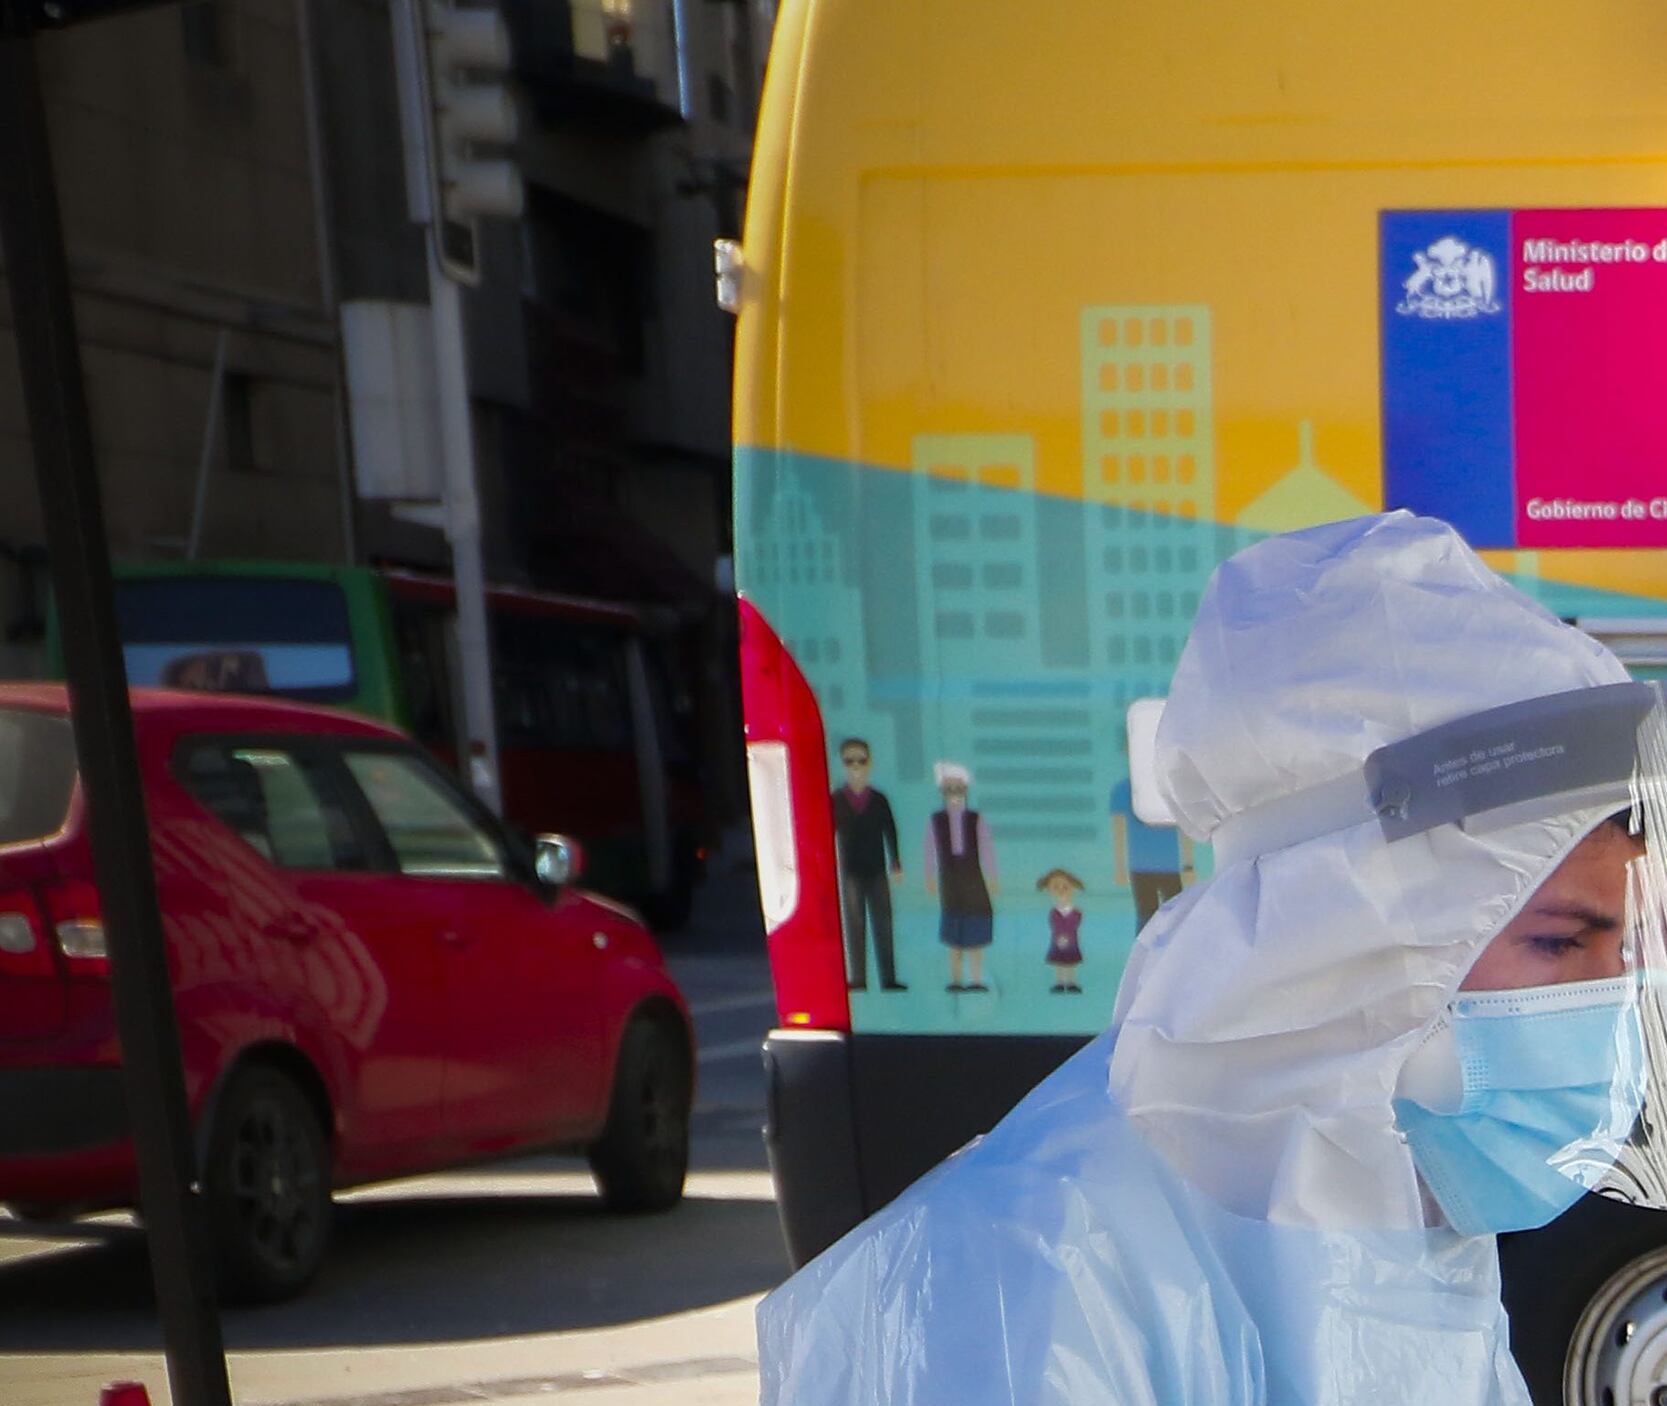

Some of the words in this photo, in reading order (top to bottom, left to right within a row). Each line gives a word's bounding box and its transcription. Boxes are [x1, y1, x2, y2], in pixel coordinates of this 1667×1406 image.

[1523, 239, 1650, 265] Ministerio
[1523, 268, 1594, 293] Salud
[1526, 498, 1618, 521] Gobierno
[1620, 499, 1647, 521] de
[1433, 757, 1468, 776] Antes
[1469, 750, 1487, 763] de
[1487, 742, 1516, 757] usar
[1436, 769, 1469, 788] retire
[1470, 760, 1501, 775] capa
[1502, 745, 1566, 768] protectora
